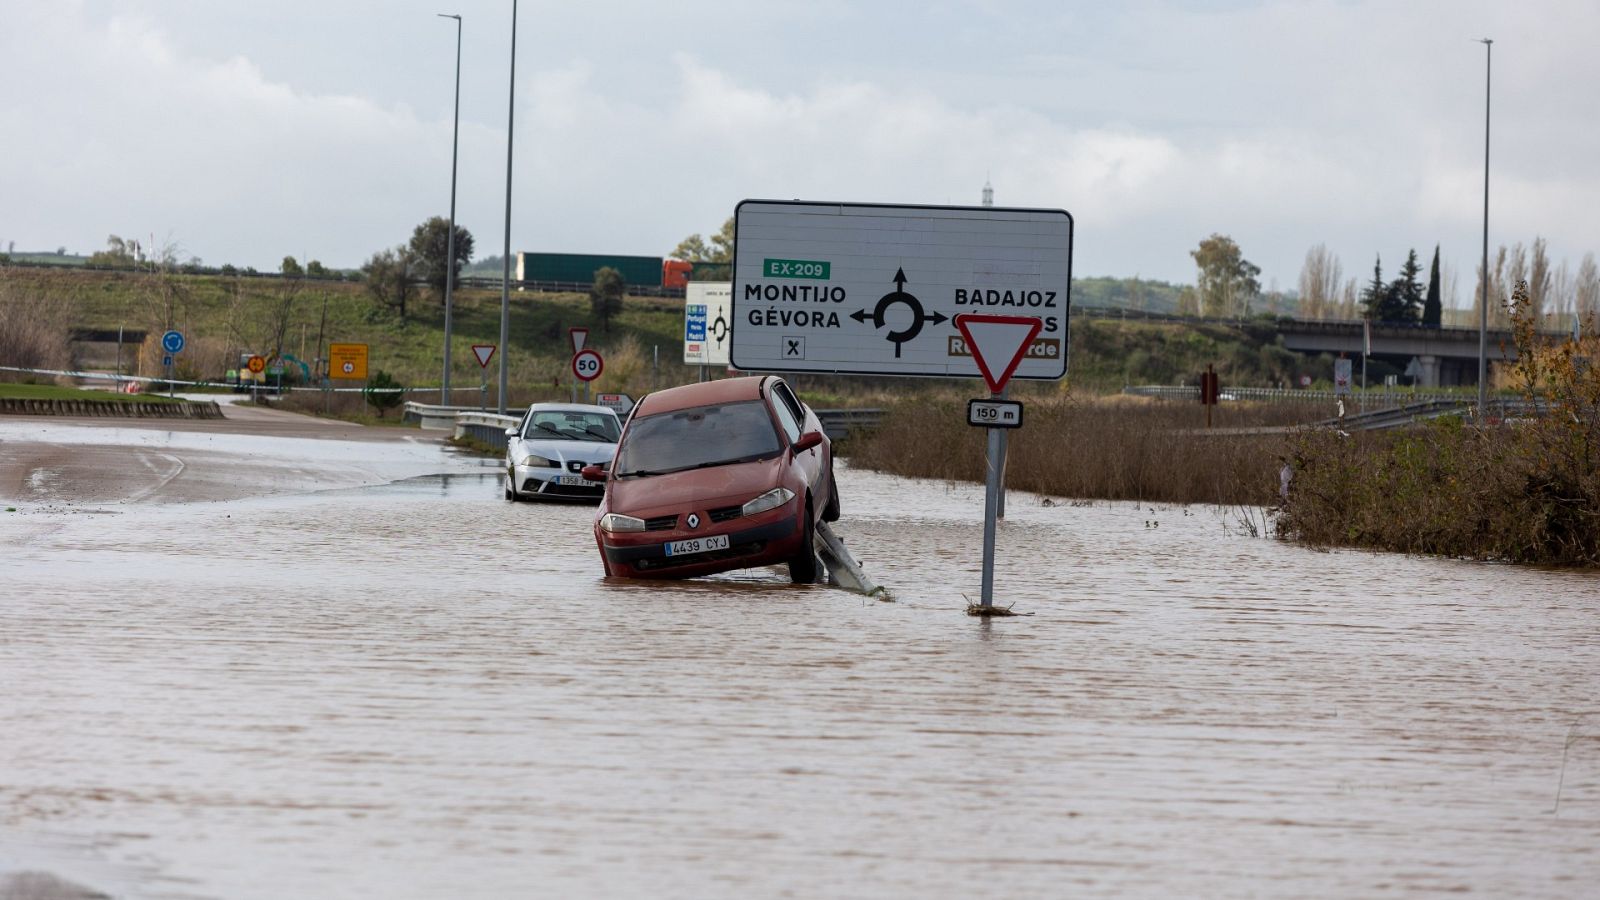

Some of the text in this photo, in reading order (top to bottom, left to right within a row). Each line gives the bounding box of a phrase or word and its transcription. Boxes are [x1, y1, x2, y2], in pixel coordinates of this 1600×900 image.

[770, 262, 823, 276] EX-209
[744, 284, 846, 303] MONTIJO
[955, 288, 1057, 308] BADAJOZ
[748, 305, 841, 328] GÉVORA
[578, 360, 597, 371] 50
[976, 408, 1014, 419] 150 m
[673, 536, 727, 554] 4439 CYJ
